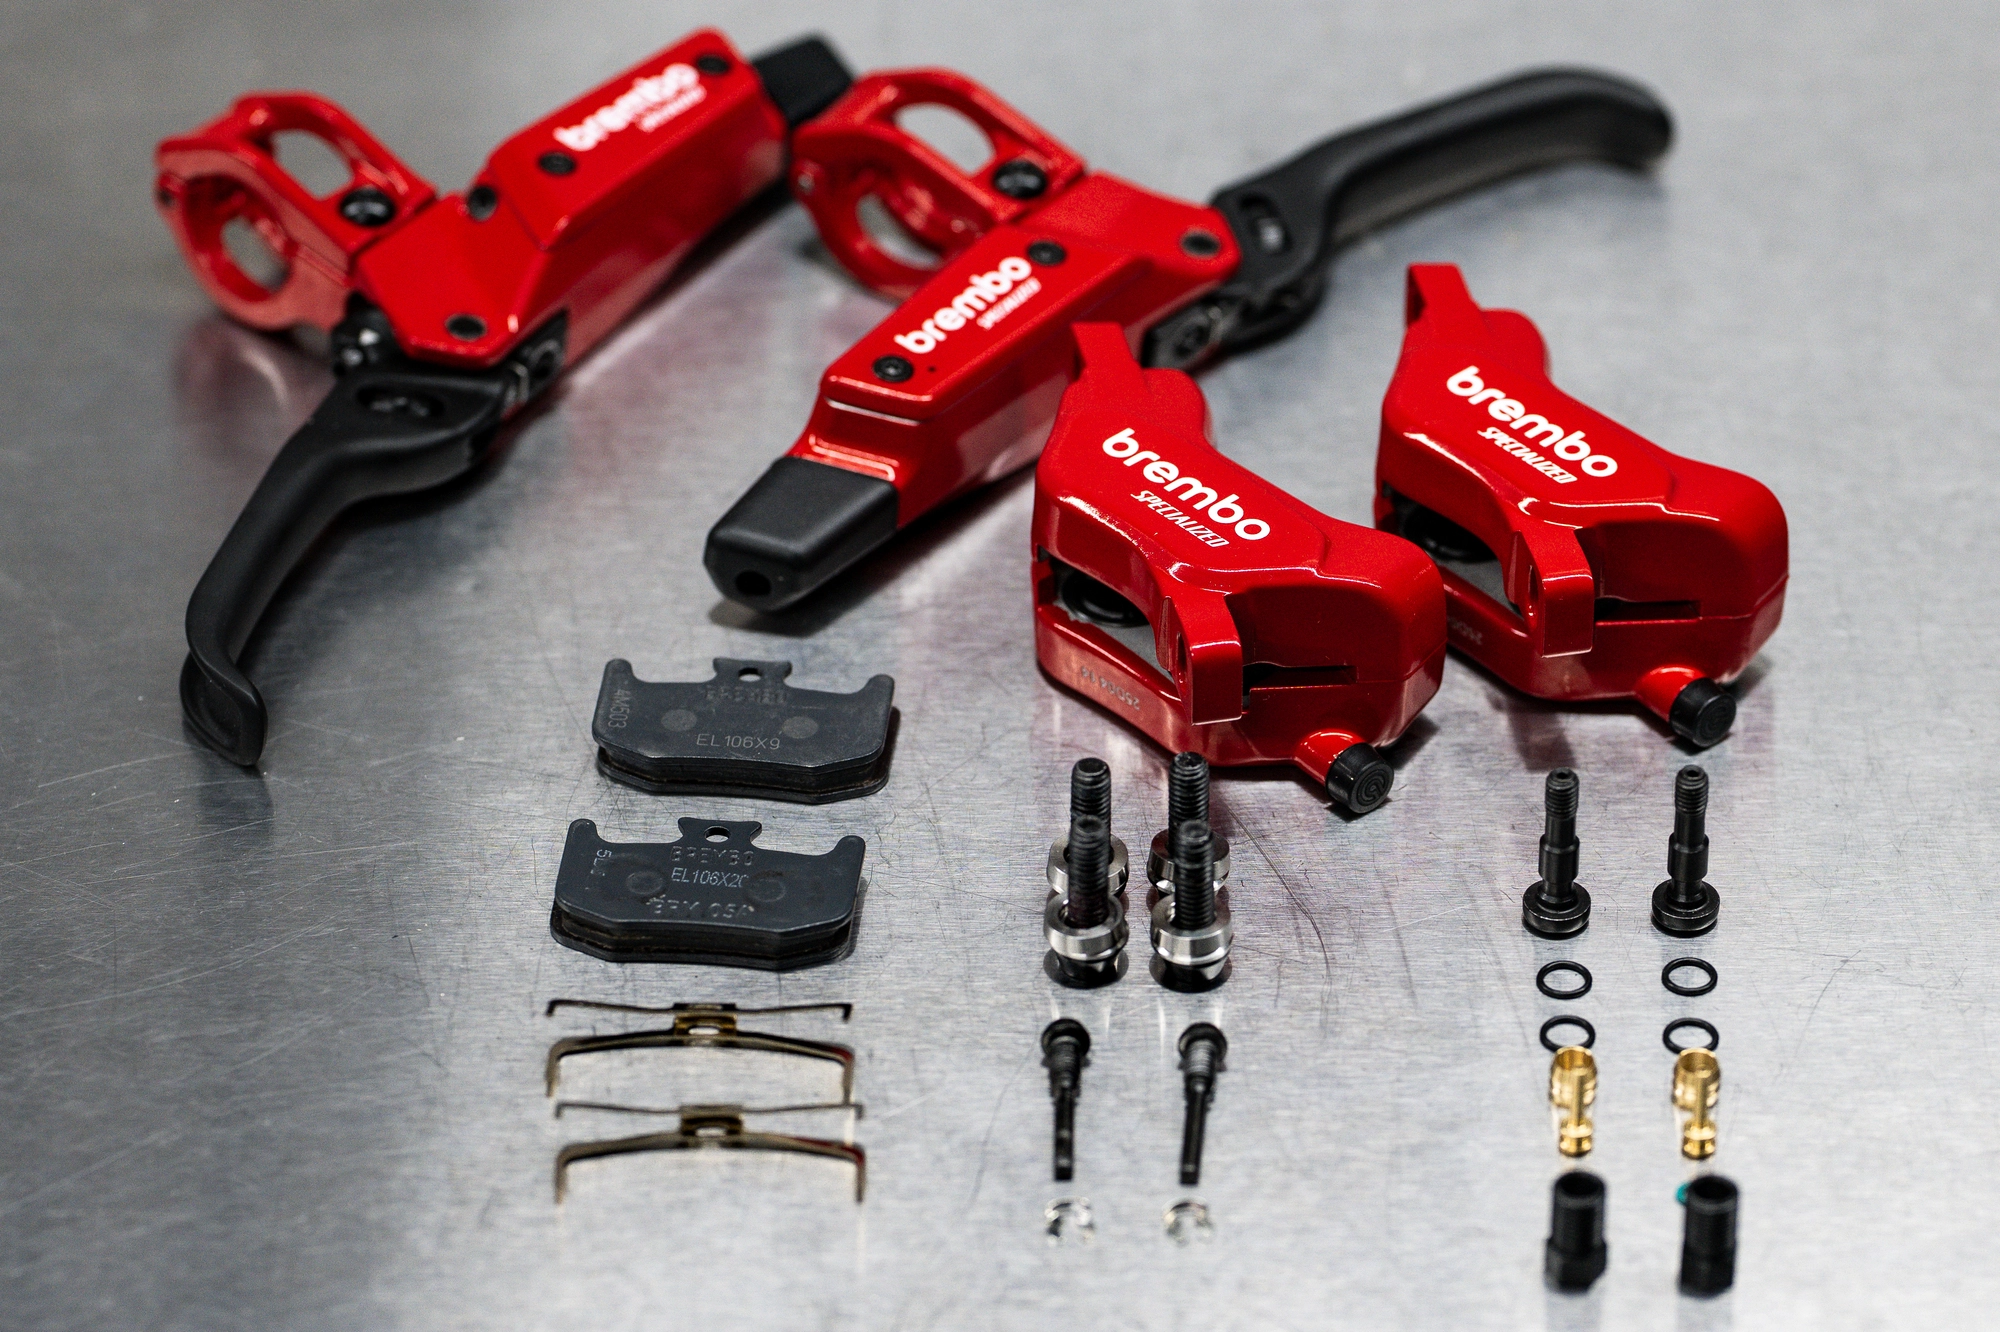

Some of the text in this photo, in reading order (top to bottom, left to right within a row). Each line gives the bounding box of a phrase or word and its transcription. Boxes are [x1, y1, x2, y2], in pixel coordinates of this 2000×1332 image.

[893, 257, 1032, 354] brembo
[1446, 365, 1618, 477] brembo
[1102, 427, 1270, 540] brembo
[1477, 426, 1578, 484] SPECIALIZED
[1130, 490, 1229, 547] SPECIALIZED
[696, 734, 780, 750] EL106X9
[670, 846, 754, 866] BREMBO
